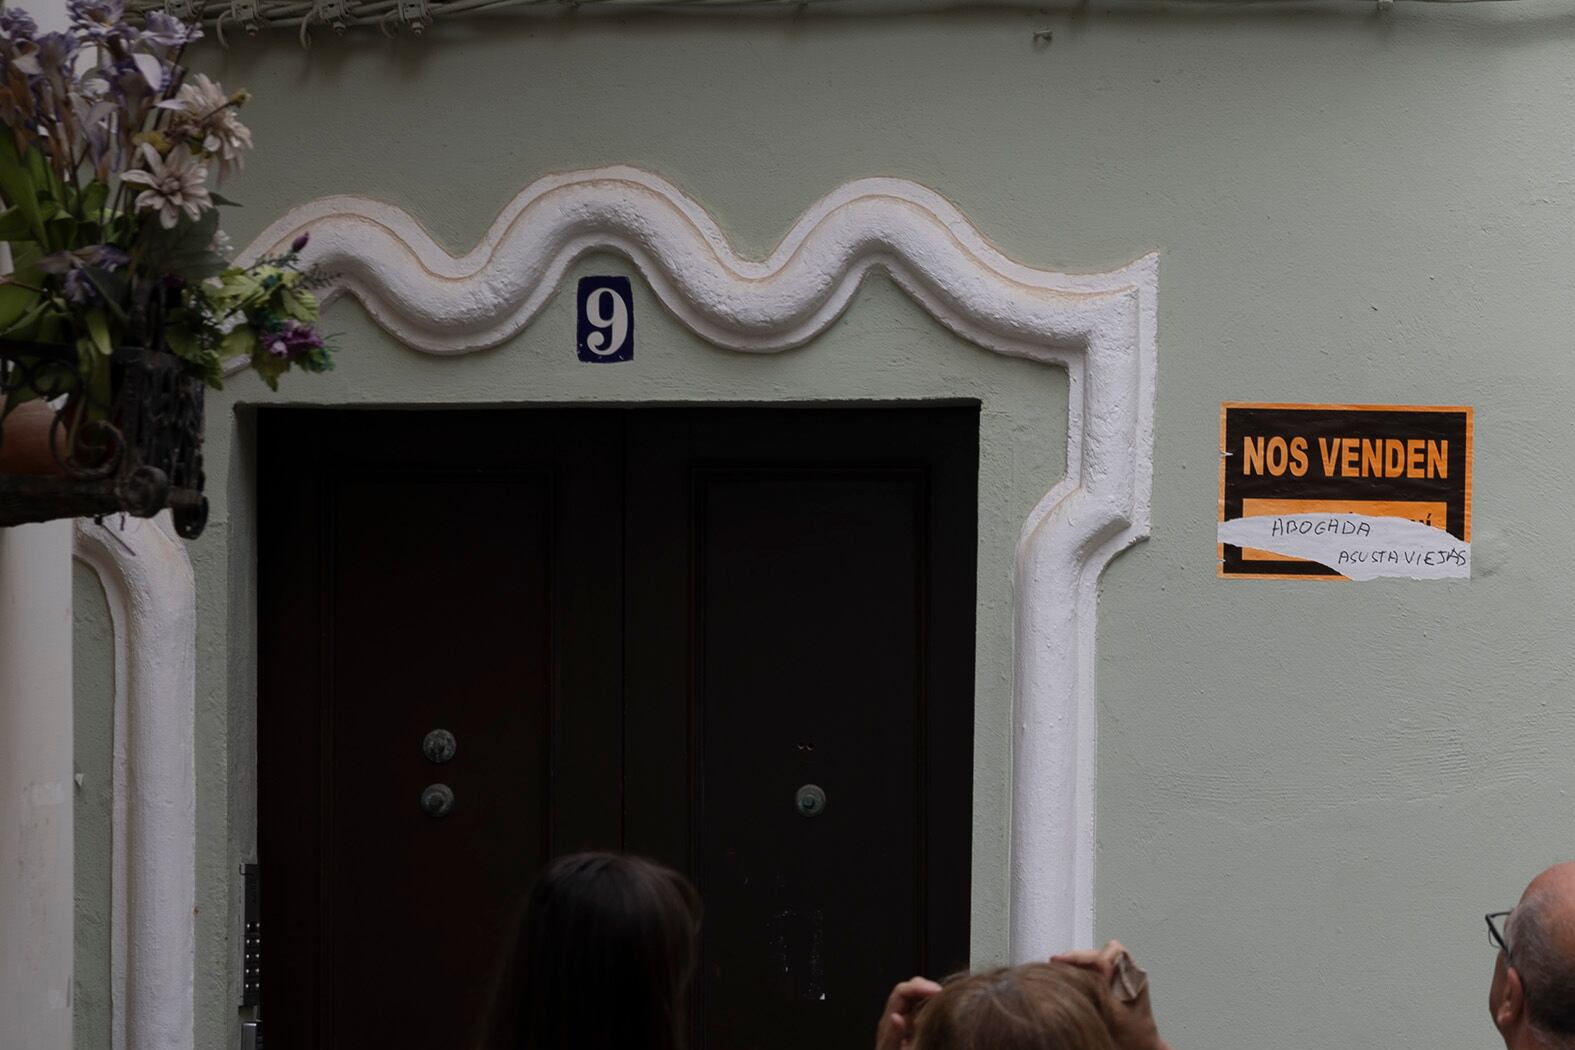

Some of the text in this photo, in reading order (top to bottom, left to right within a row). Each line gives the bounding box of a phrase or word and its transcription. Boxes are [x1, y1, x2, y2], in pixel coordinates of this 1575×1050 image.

[586, 287, 629, 356] 9
[1242, 436, 1448, 479] NOS VENDEN
[1272, 517, 1371, 537] ABOGADA
